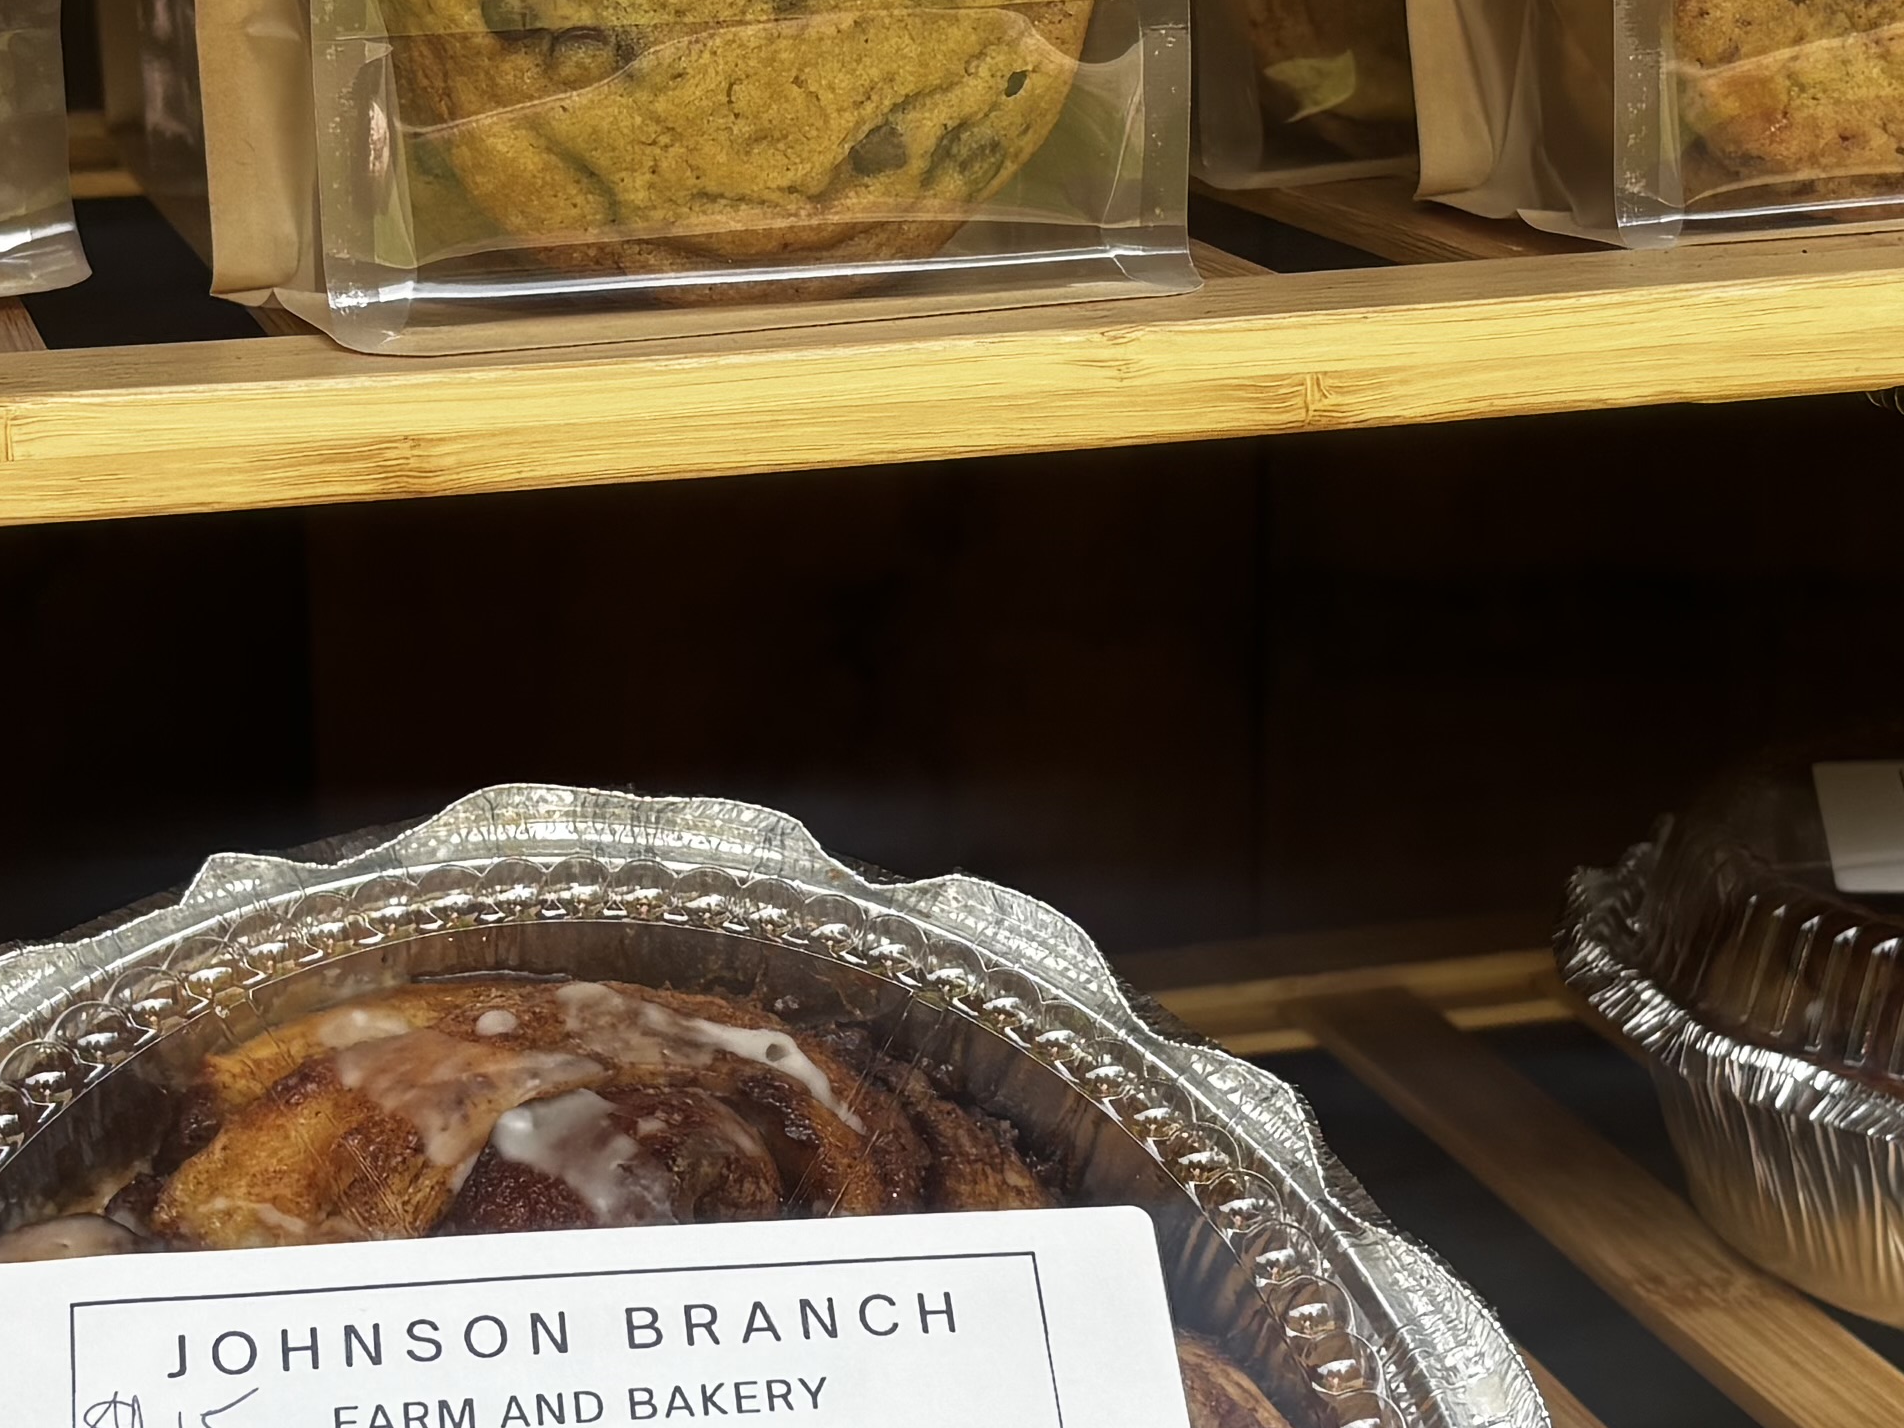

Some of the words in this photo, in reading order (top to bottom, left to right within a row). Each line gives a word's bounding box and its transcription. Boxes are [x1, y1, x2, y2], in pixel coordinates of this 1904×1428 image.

[166, 1310, 570, 1380] JOHNSON
[623, 1290, 957, 1351] BRANCH
[627, 1375, 828, 1422] BAKERY
